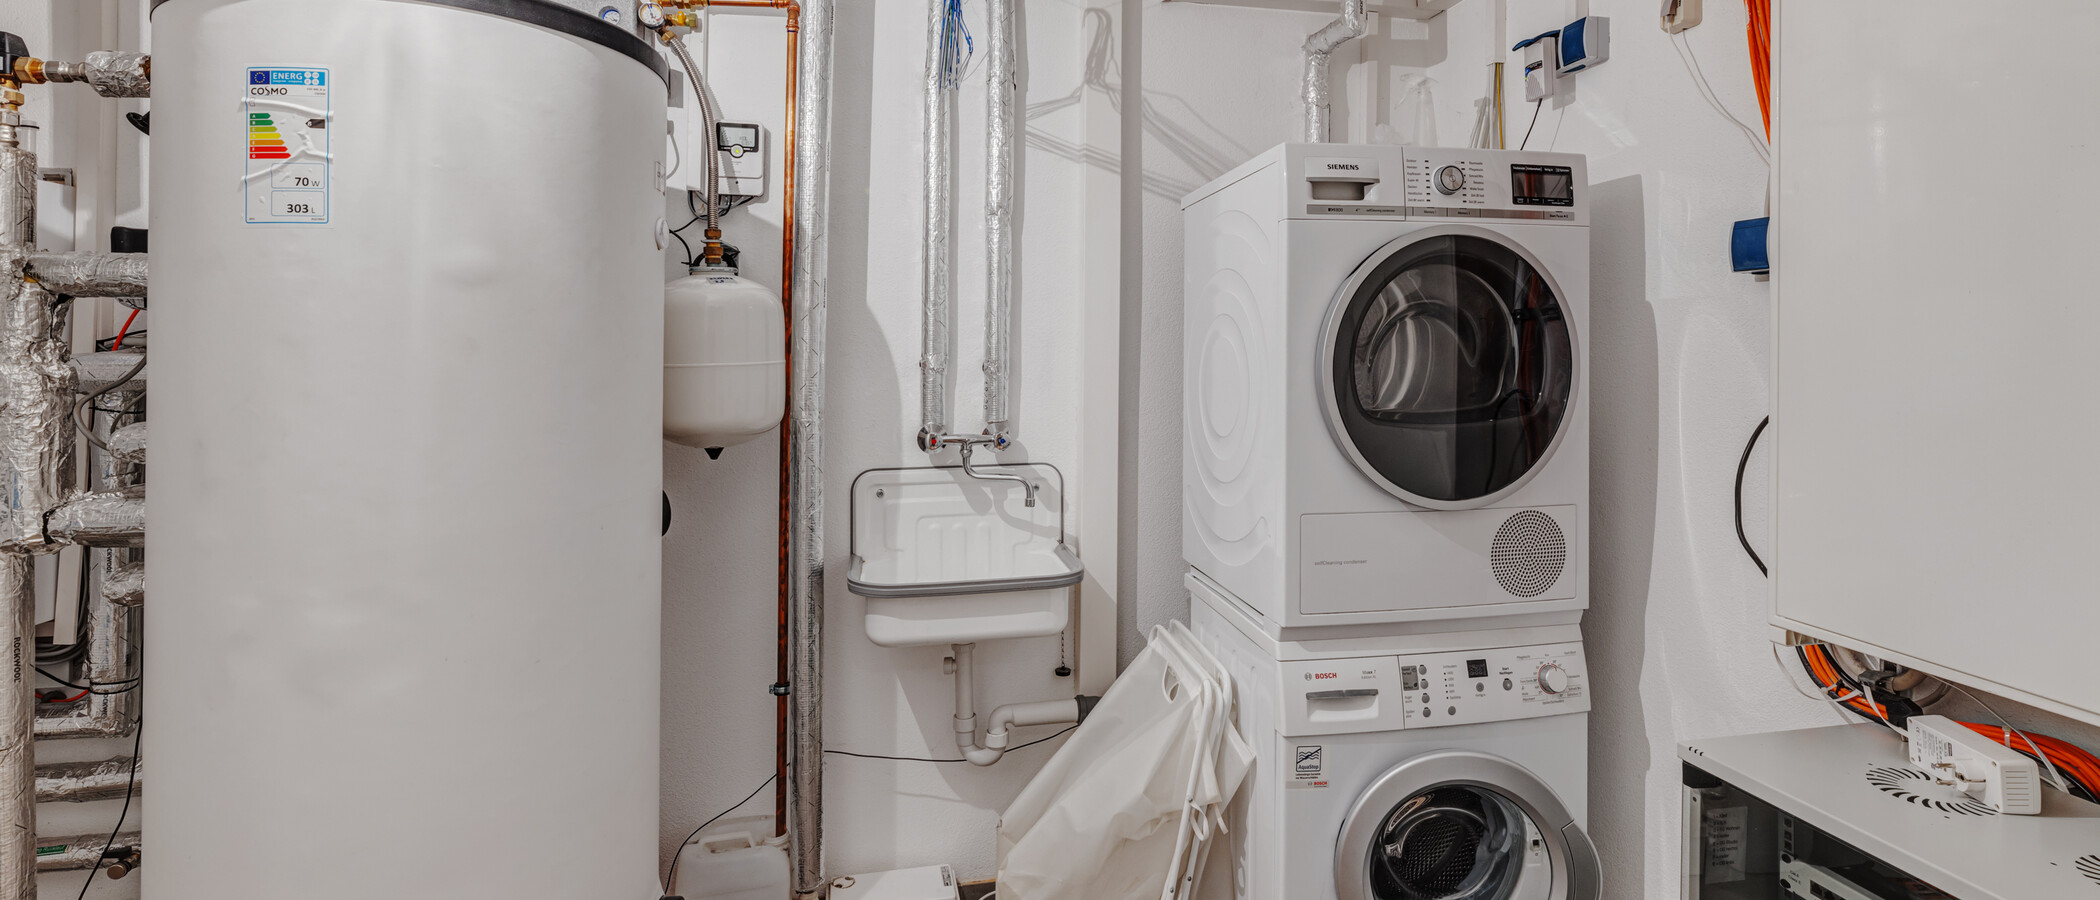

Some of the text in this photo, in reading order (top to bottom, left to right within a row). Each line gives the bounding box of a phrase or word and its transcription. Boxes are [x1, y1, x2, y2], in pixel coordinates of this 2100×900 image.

[273, 72, 303, 80] ENERG
[251, 87, 288, 95] COSMO
[295, 177, 309, 187] 70
[287, 204, 309, 213] 303
